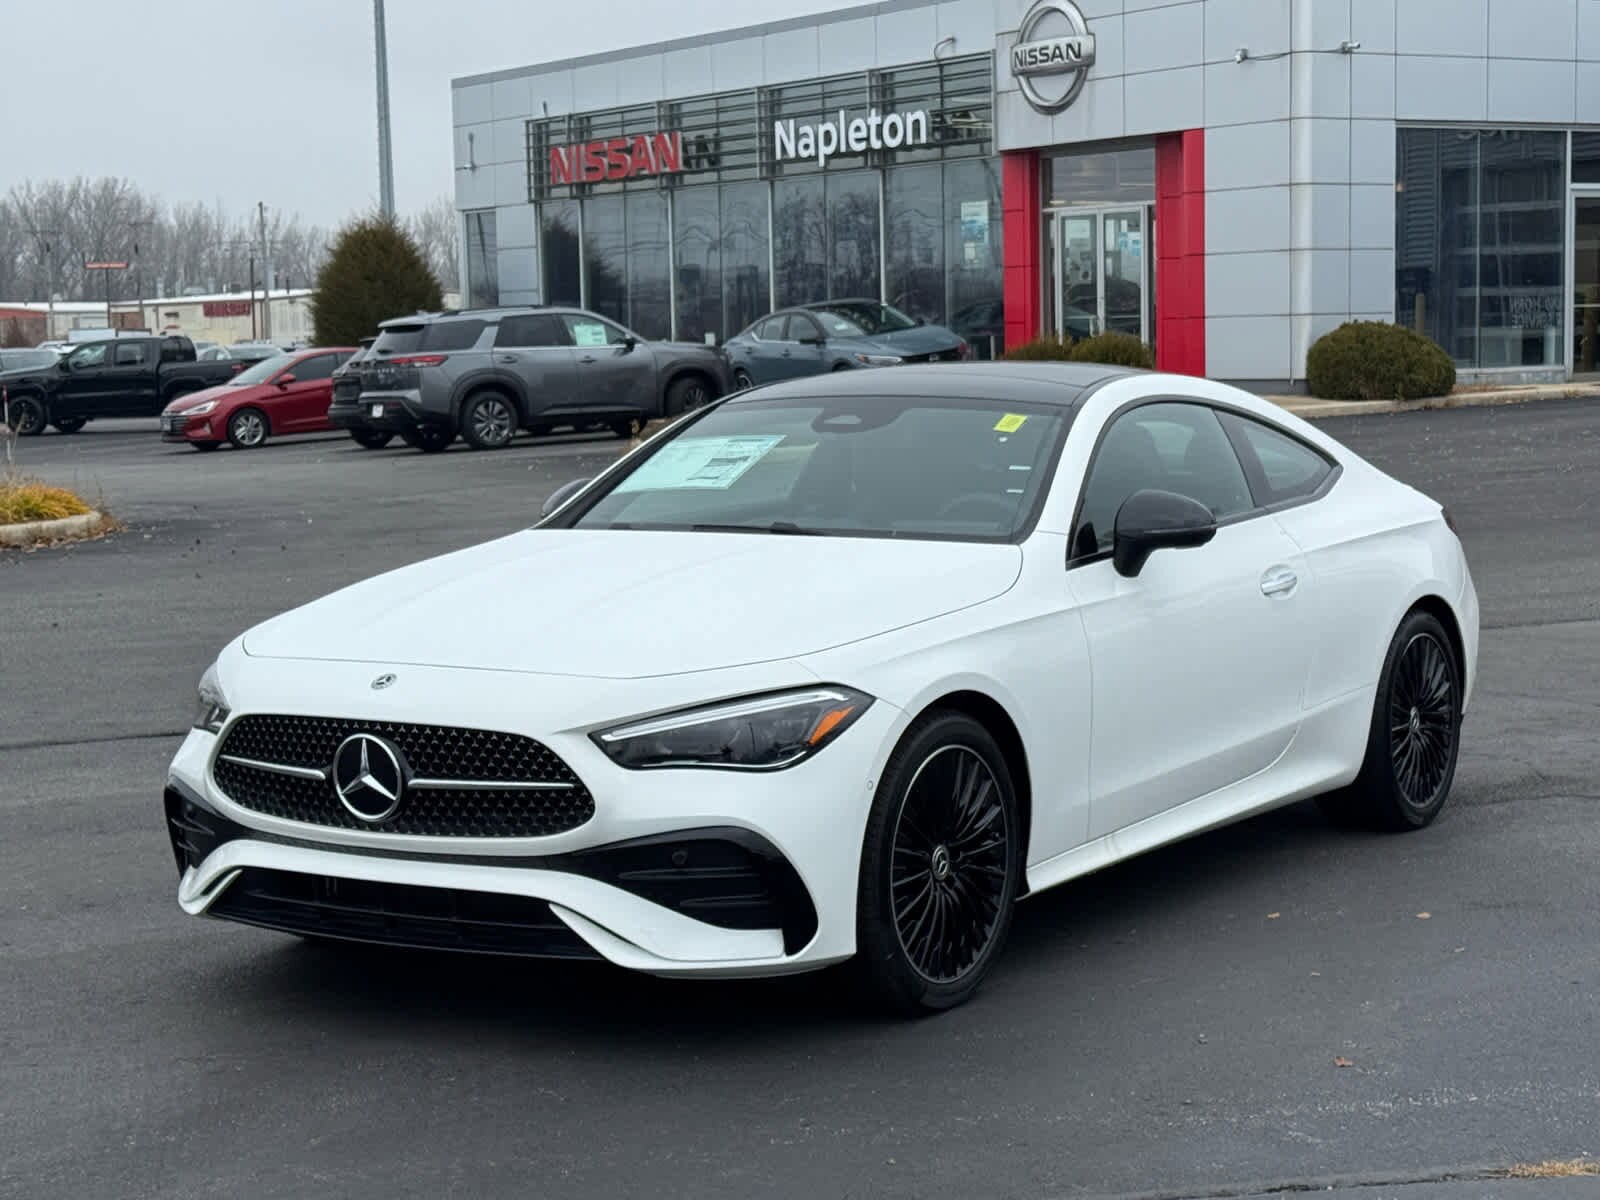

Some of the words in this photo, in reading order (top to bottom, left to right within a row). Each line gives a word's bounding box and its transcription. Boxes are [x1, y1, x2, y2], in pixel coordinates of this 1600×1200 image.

[1014, 42, 1081, 68] NISSAN
[549, 130, 682, 185] NISSAN
[774, 108, 927, 167] Napleton
